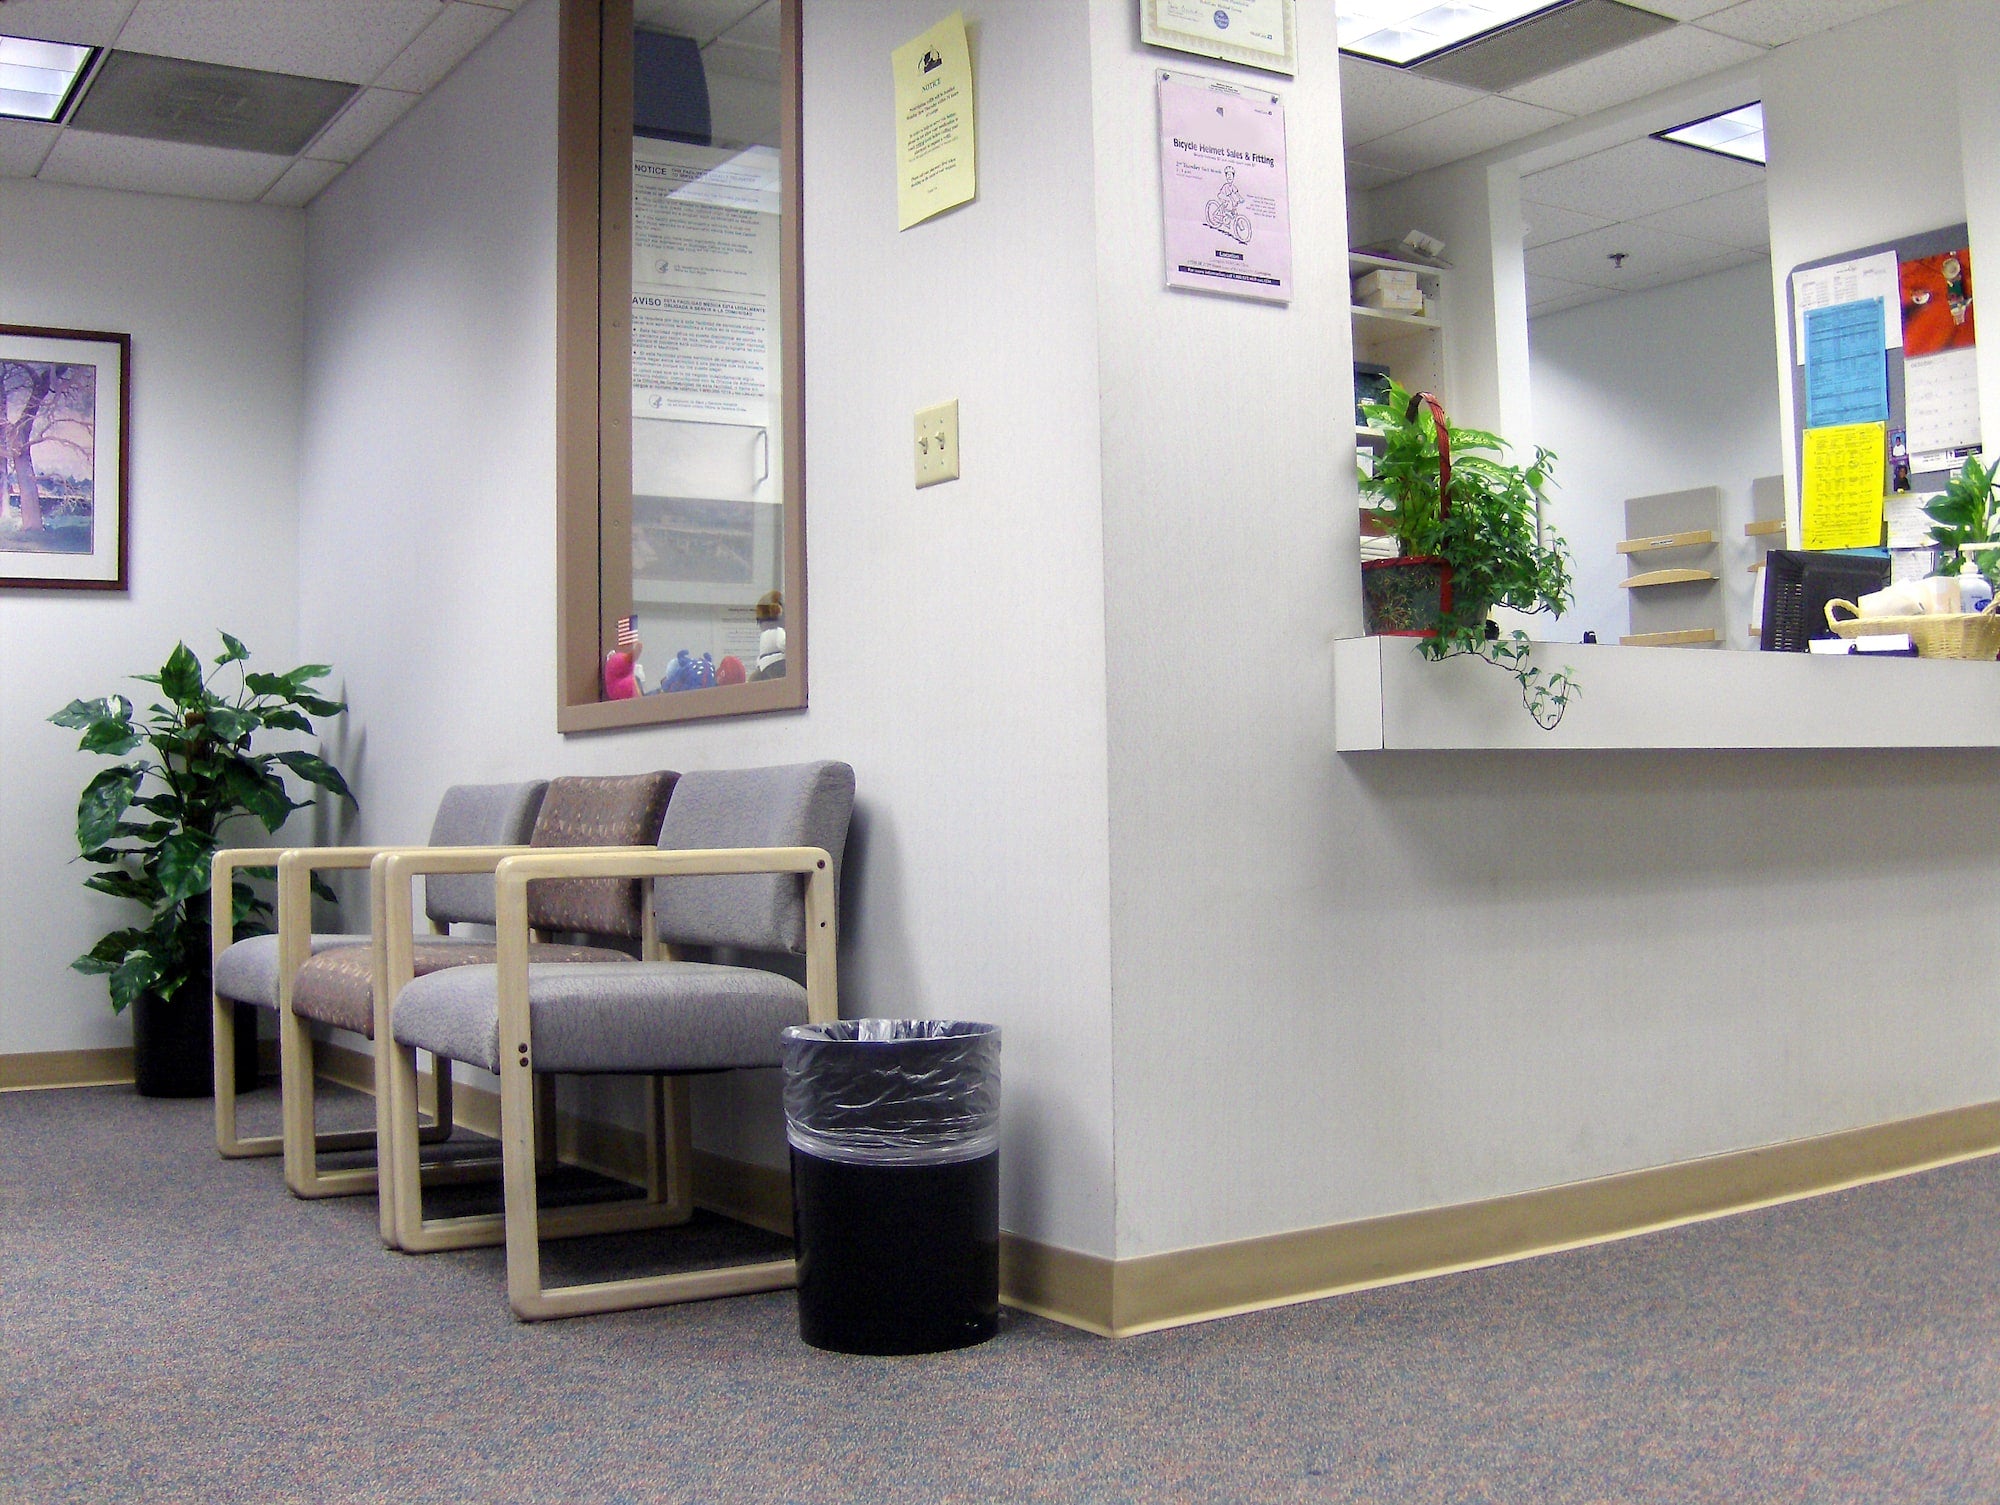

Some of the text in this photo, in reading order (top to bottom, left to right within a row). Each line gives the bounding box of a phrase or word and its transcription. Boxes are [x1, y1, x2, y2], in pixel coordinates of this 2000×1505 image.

[1173, 138, 1198, 151] Bicycle
[1199, 144, 1225, 156] Helmet
[1226, 149, 1243, 160] Sales
[1244, 152, 1250, 161] &
[1252, 153, 1275, 168] Fitting
[634, 164, 667, 175] NOTICE
[632, 297, 661, 306] AVISO
